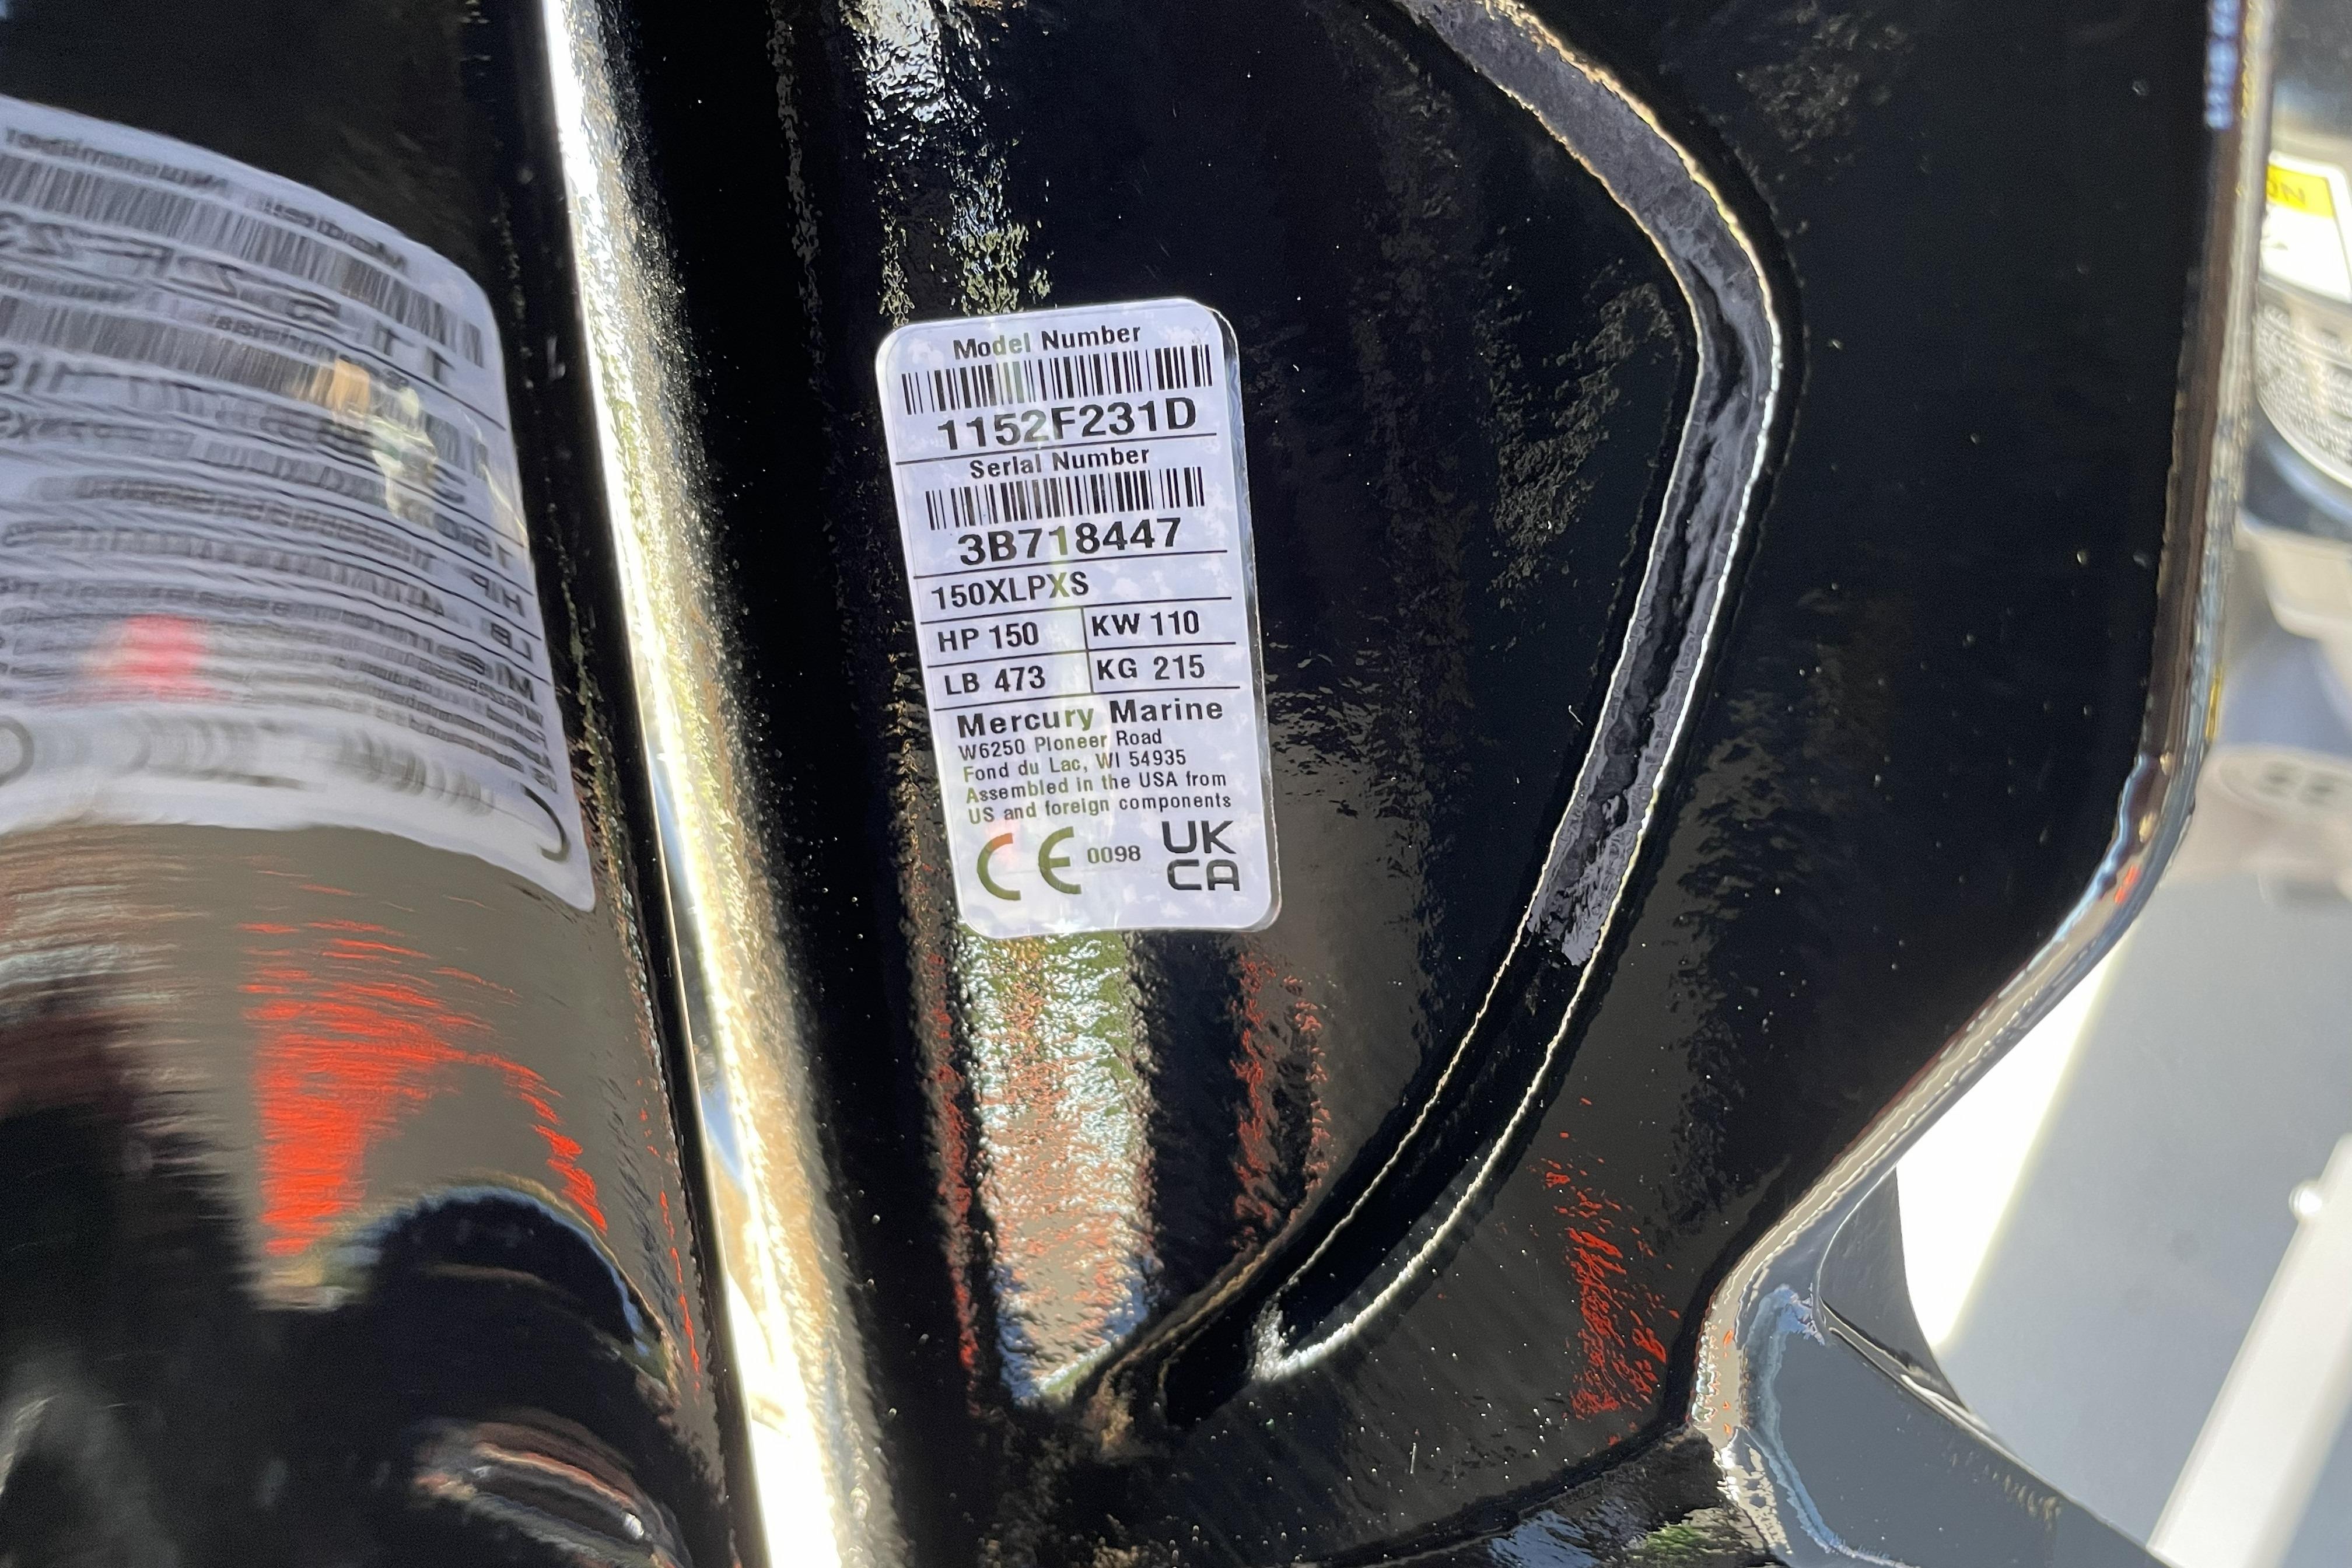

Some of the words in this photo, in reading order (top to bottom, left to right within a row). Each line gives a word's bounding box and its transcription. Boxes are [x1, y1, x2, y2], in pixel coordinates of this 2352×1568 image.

[953, 332, 1031, 359] Model
[1041, 324, 1141, 351] Number
[937, 397, 1196, 450] 1152F231D
[970, 453, 1041, 479] Serial
[1052, 447, 1149, 471] Number
[957, 517, 1181, 566] 3B718447
[931, 571, 1088, 610] 150XLPXS
[937, 627, 979, 653] HP
[989, 622, 1039, 649] 150
[1091, 613, 1140, 637] KW
[1151, 610, 1199, 636] 110
[944, 671, 979, 696] LB
[995, 666, 1045, 692] 473
[1097, 658, 1137, 680] KG
[1154, 654, 1205, 680] 215
[957, 708, 1094, 738] Mercury
[1110, 698, 1223, 724] Marine
[959, 738, 1026, 761] W6250
[1035, 733, 1108, 753] Pioneer
[1116, 729, 1162, 746] Road
[964, 760, 1009, 782] Fond
[1018, 757, 1040, 776] du
[1049, 757, 1088, 774] Lac,
[1096, 752, 1121, 769] WI
[1129, 749, 1186, 766] 54935
[966, 779, 1069, 804] Assembled
[1076, 774, 1093, 791] in
[1102, 773, 1130, 790] the
[1139, 771, 1178, 788] USA
[1186, 770, 1226, 787] from
[968, 807, 994, 824] US
[1003, 802, 1037, 820] and
[1045, 797, 1110, 817] foreign
[1119, 792, 1231, 813] components
[1162, 821, 1237, 855] UK
[1087, 846, 1141, 864] 0098
[1166, 859, 1240, 891] CA
